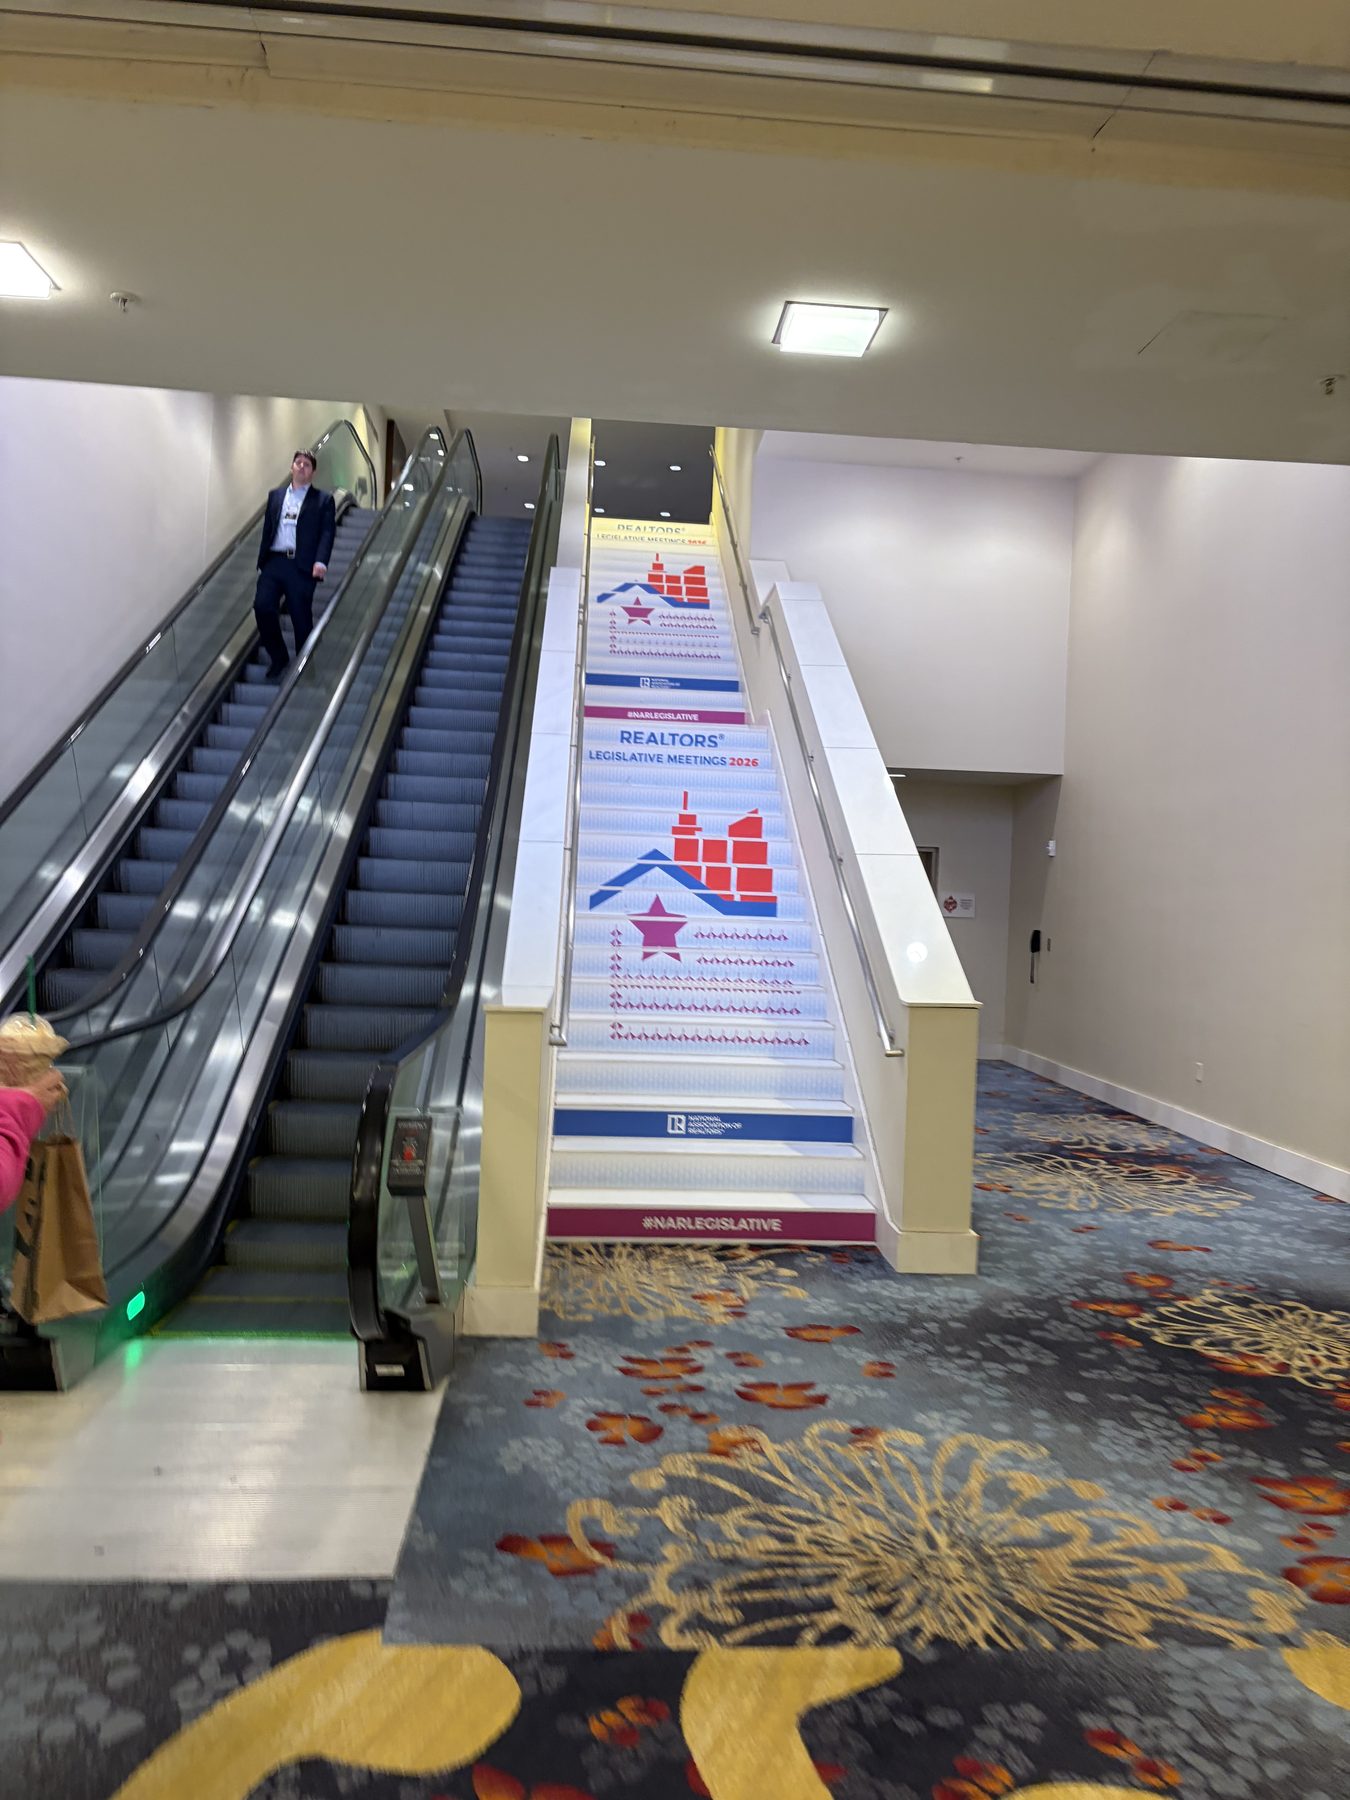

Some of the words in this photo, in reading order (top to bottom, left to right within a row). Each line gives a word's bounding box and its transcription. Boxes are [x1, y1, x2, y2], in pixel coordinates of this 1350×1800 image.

[627, 711, 699, 721] #NARLEGISLATIVE
[589, 750, 663, 763] LEGISLATIVE
[667, 755, 727, 766] MEETINGS
[729, 757, 759, 767] 2026
[642, 1216, 783, 1232] #NARLEGISLATIVE
